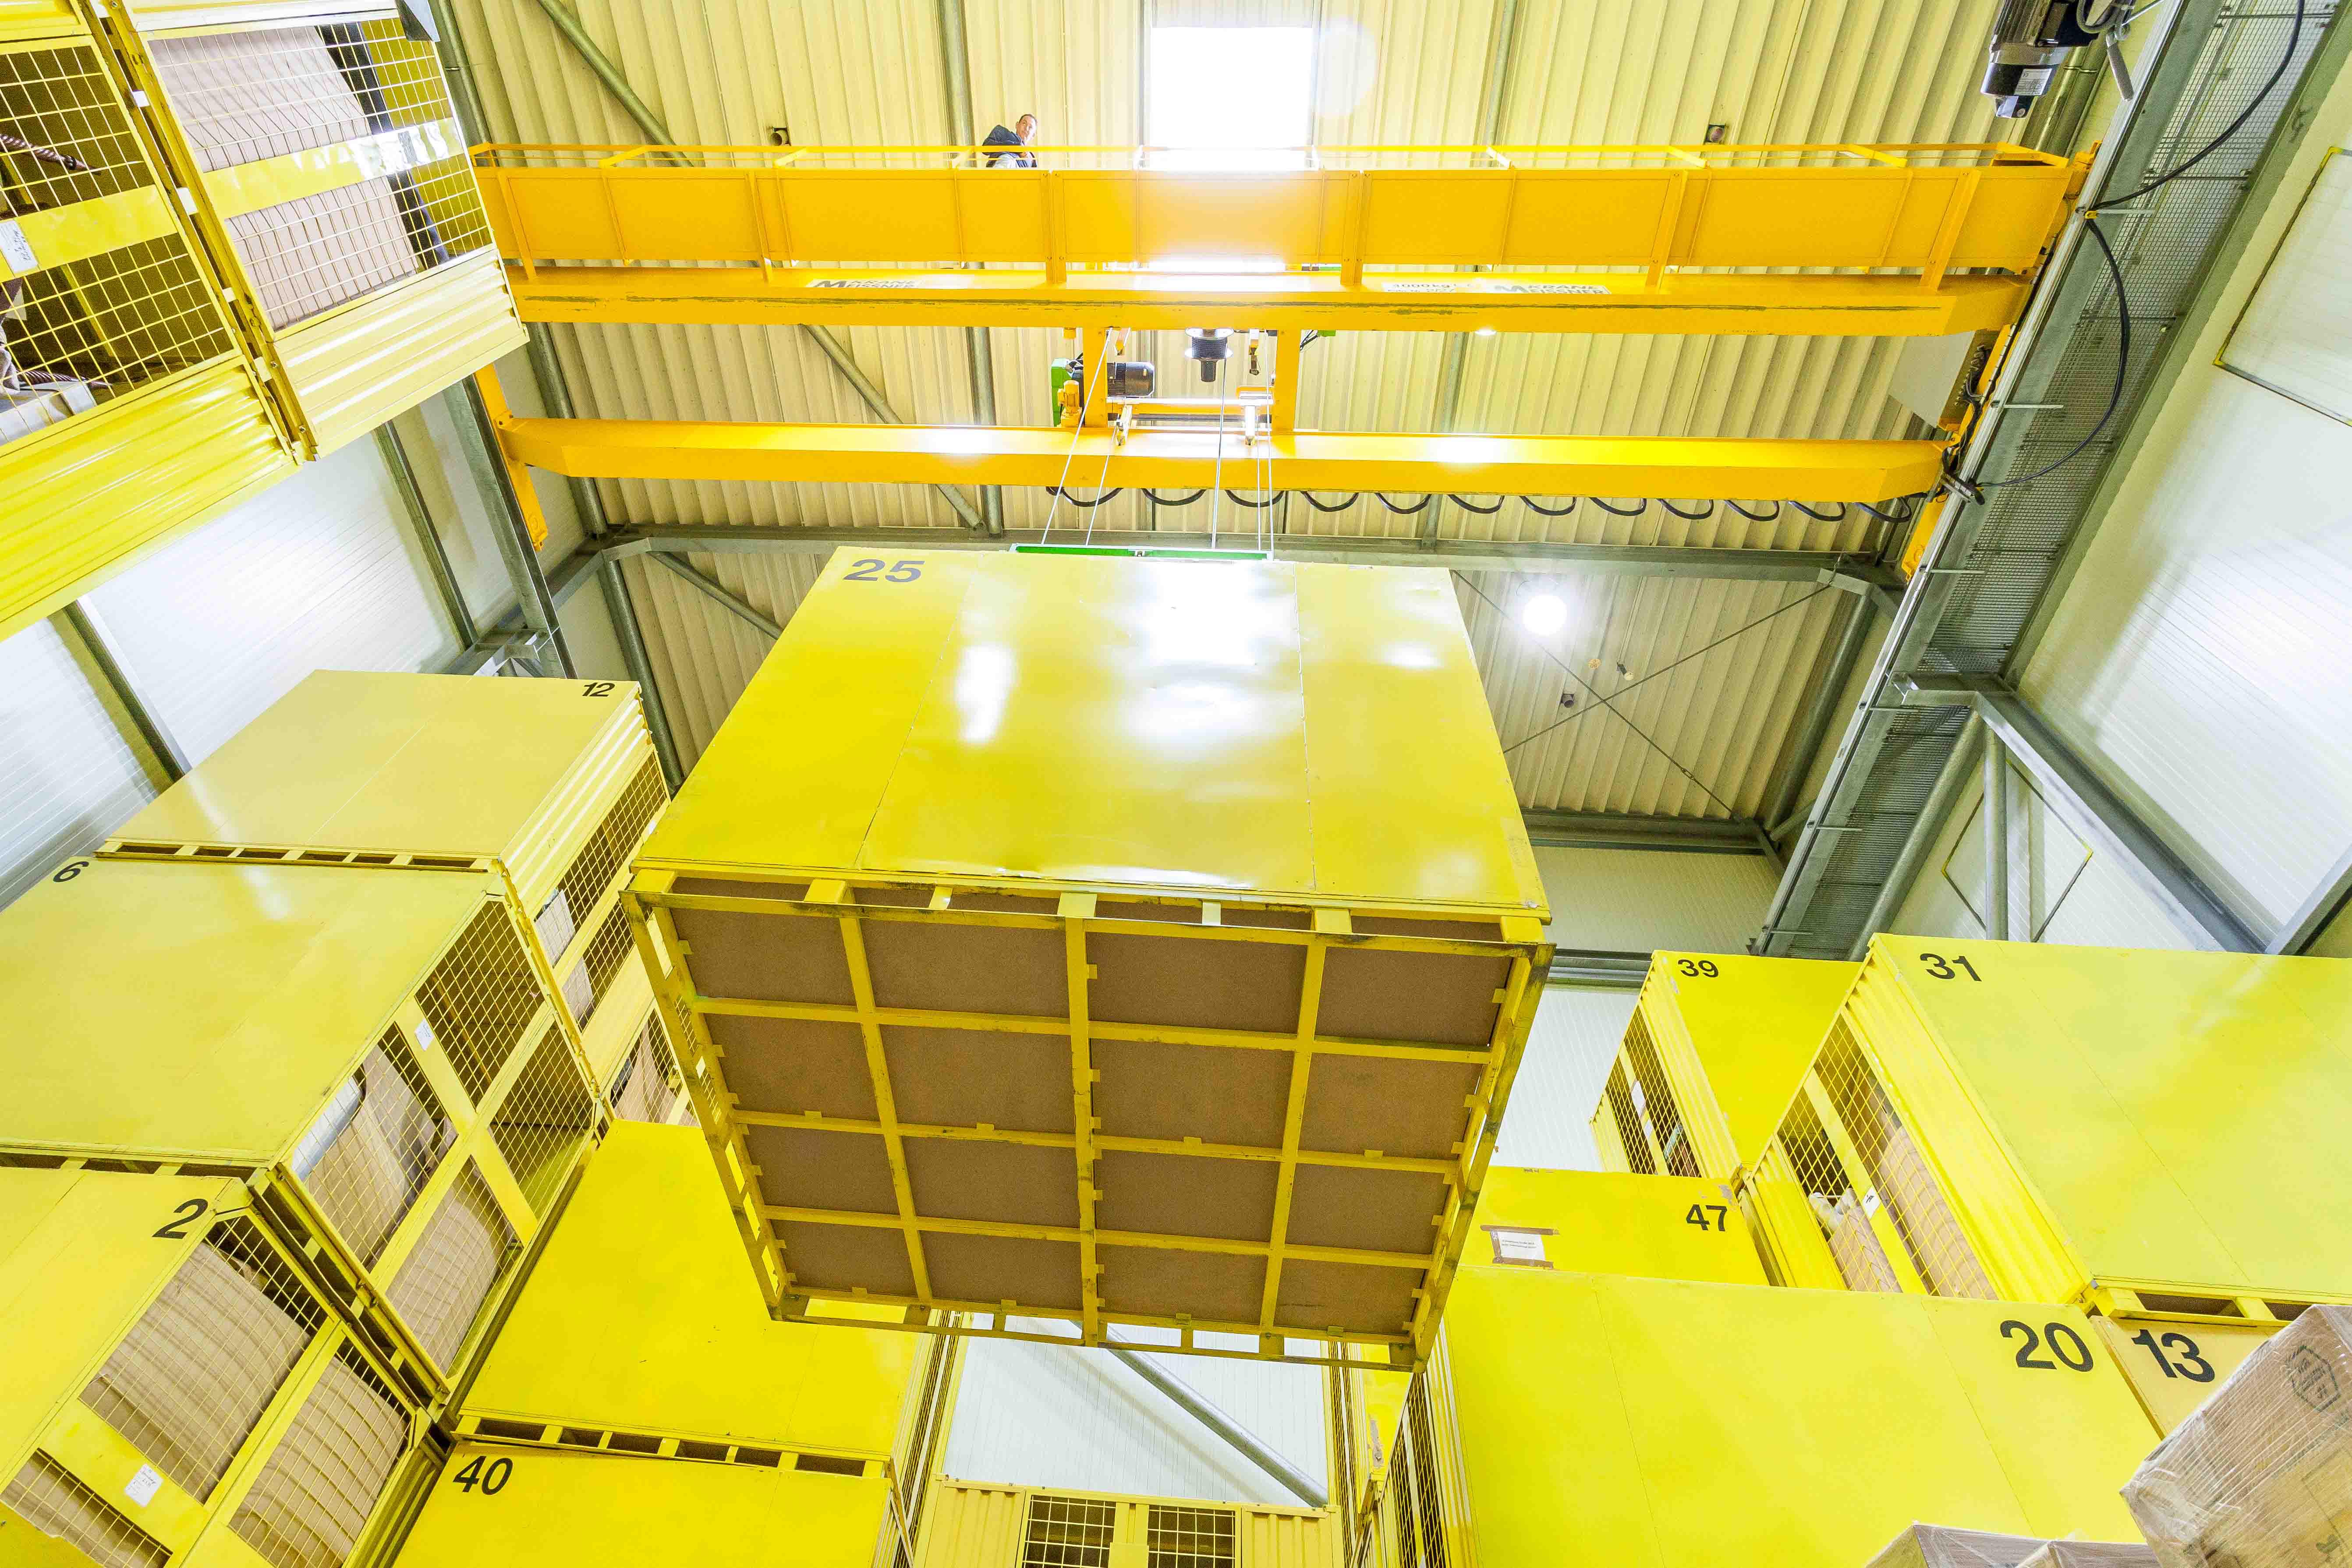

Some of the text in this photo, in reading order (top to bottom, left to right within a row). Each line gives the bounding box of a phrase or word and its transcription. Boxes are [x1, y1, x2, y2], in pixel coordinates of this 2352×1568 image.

[843, 559, 925, 582] 25
[582, 682, 615, 697] 12
[53, 861, 89, 883] 6
[1678, 959, 1718, 978] 39
[1920, 953, 1982, 981] 31
[152, 1198, 208, 1239] 2
[1686, 1204, 1727, 1232] 47
[2000, 1320, 2093, 1372] 20
[2131, 1329, 2215, 1383] 13
[453, 1455, 513, 1495] 40
